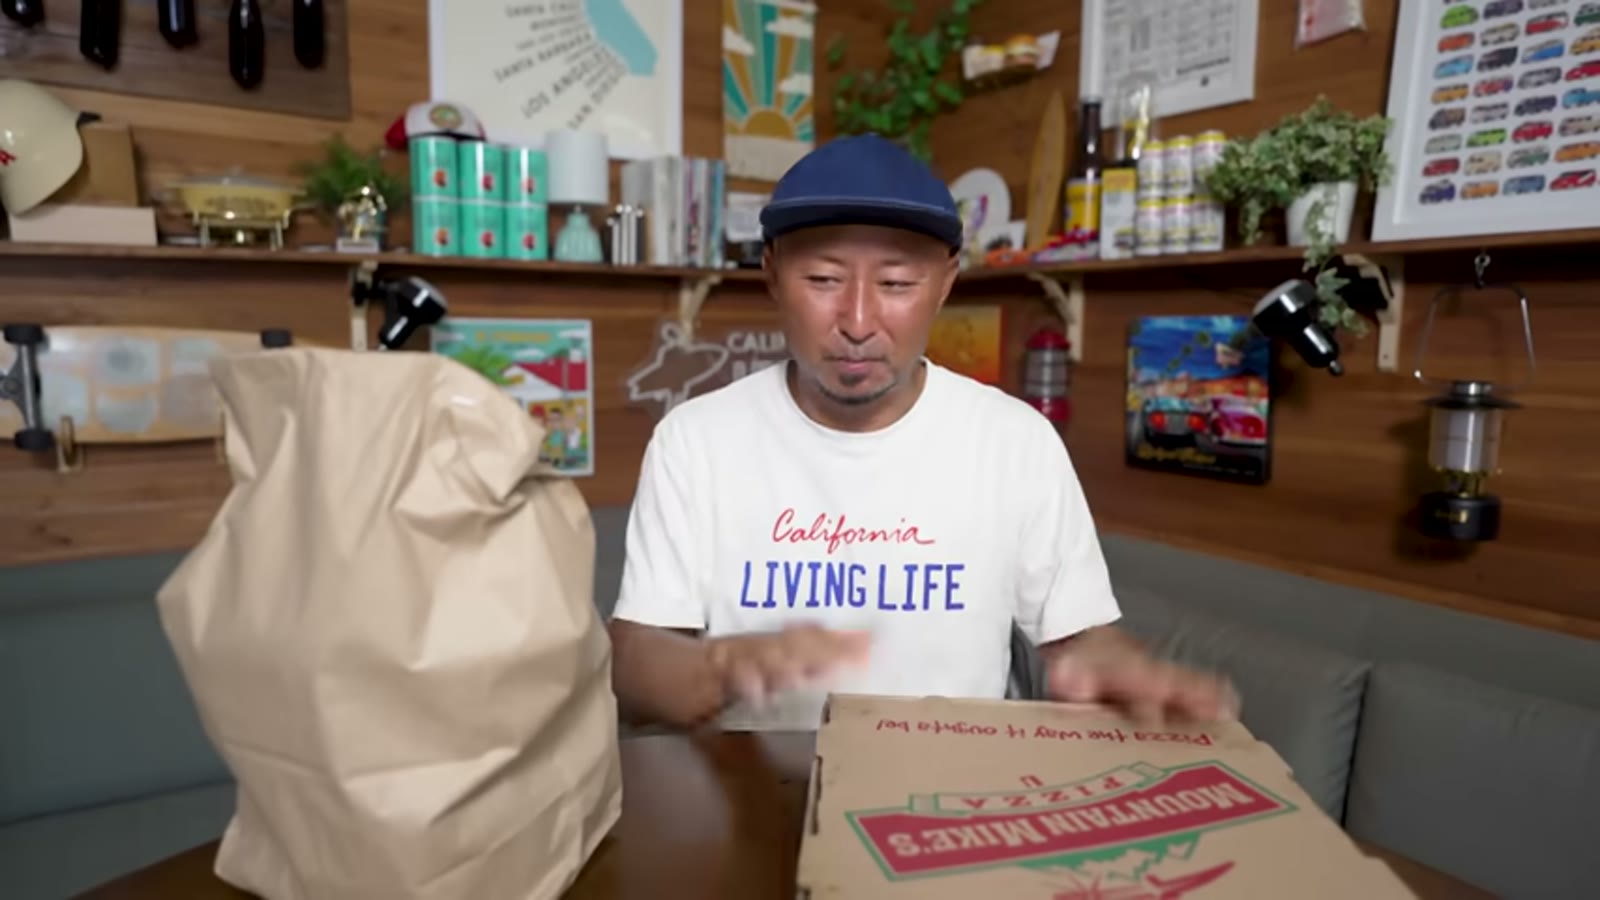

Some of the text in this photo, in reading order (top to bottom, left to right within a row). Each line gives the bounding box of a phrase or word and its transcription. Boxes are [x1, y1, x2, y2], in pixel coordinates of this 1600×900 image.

[521, 90, 551, 120] LOS
[771, 507, 937, 555] California
[740, 560, 966, 612] LIVING LIFE
[876, 719, 1214, 747] Pizza the way it oughta be!
[960, 776, 1124, 809] PIZZA
[886, 782, 1257, 857] MOUNTAIN MIKE'S
